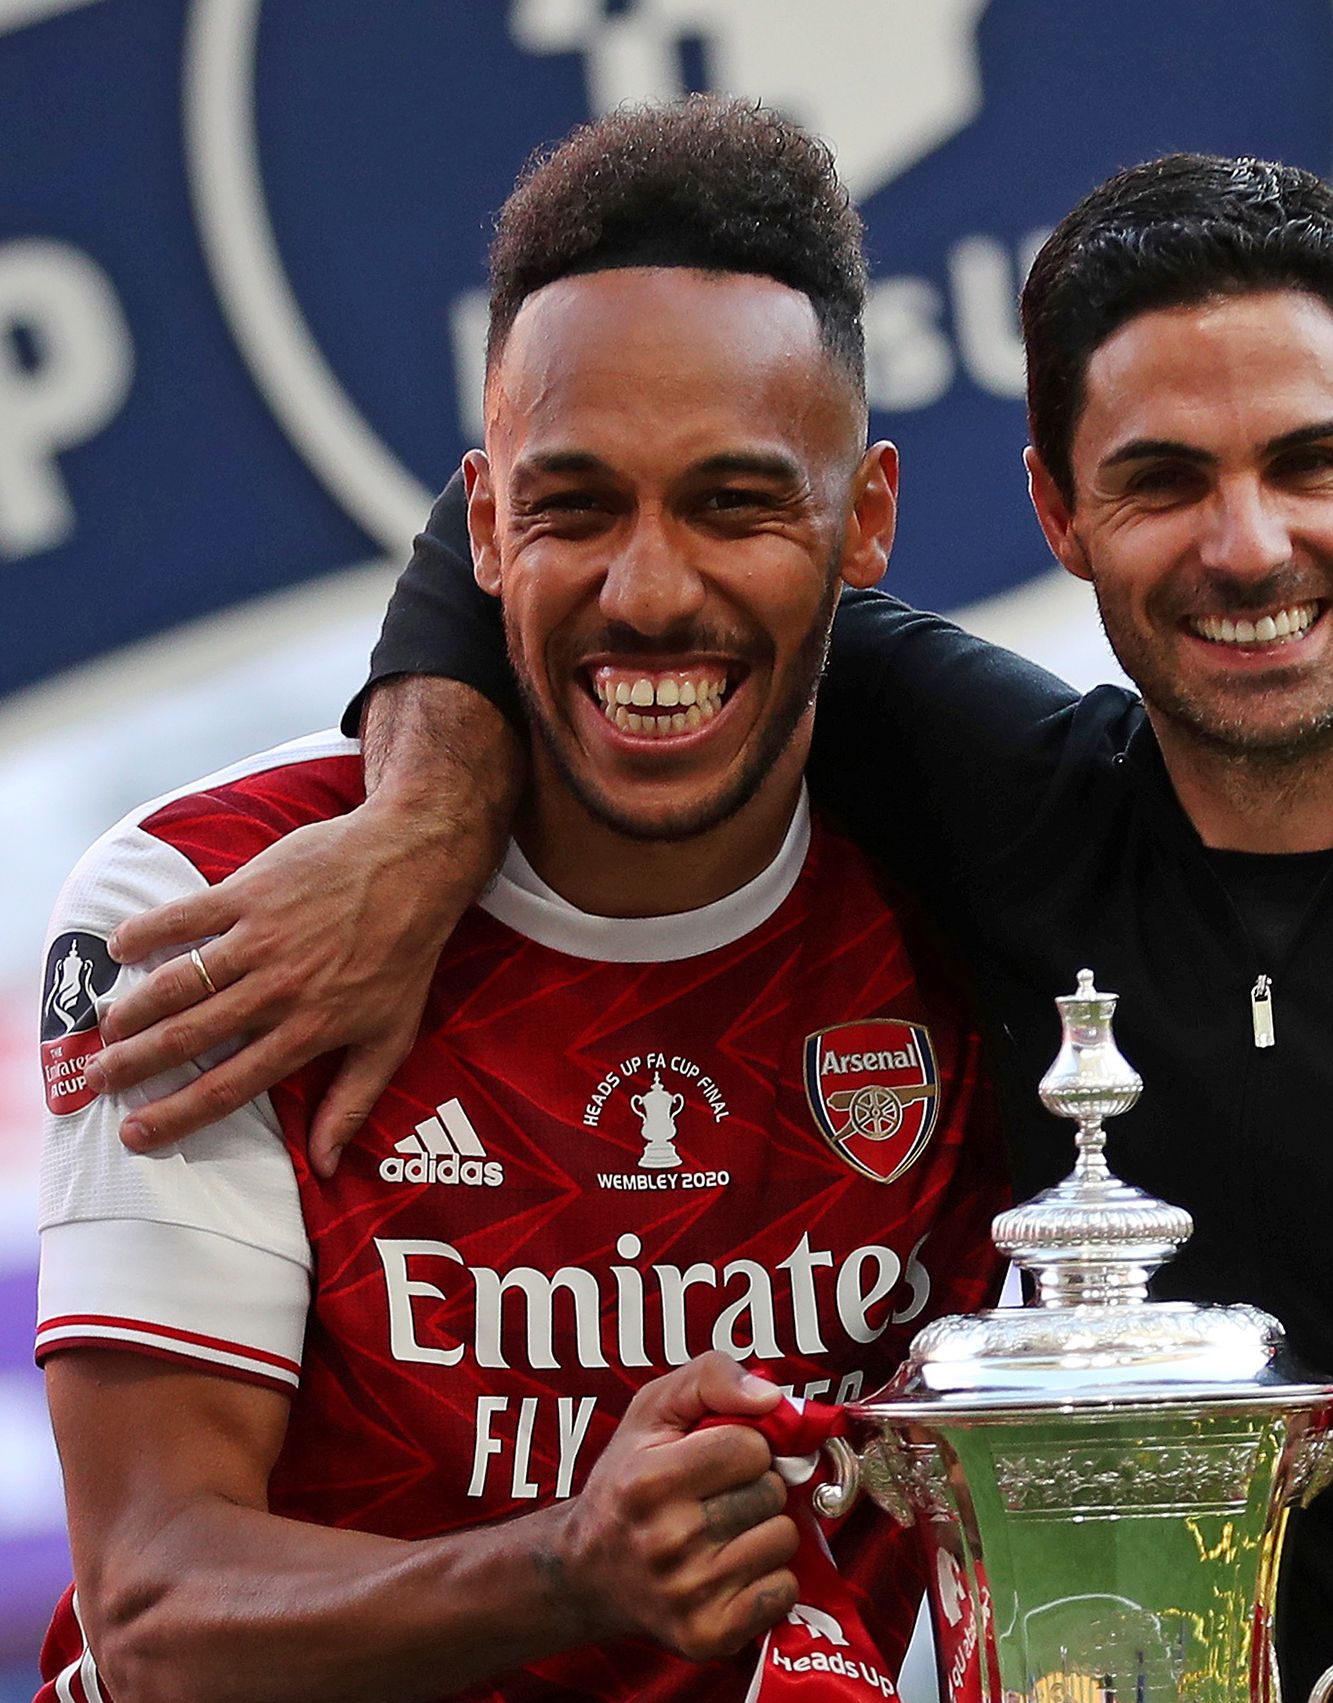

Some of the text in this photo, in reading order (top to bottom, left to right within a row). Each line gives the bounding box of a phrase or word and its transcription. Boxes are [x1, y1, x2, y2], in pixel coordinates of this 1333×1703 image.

[820, 1043, 918, 1076] Arsenal
[57, 1075, 87, 1097] CUP
[583, 1053, 730, 1126] HEADS UP FA CUP FINAL
[379, 1151, 504, 1187] adidas
[596, 1170, 730, 1190] WEMBLEY 2020
[374, 1230, 931, 1368] Emirates
[467, 1396, 597, 1499] FLY
[772, 1647, 895, 1697] Heads Up
